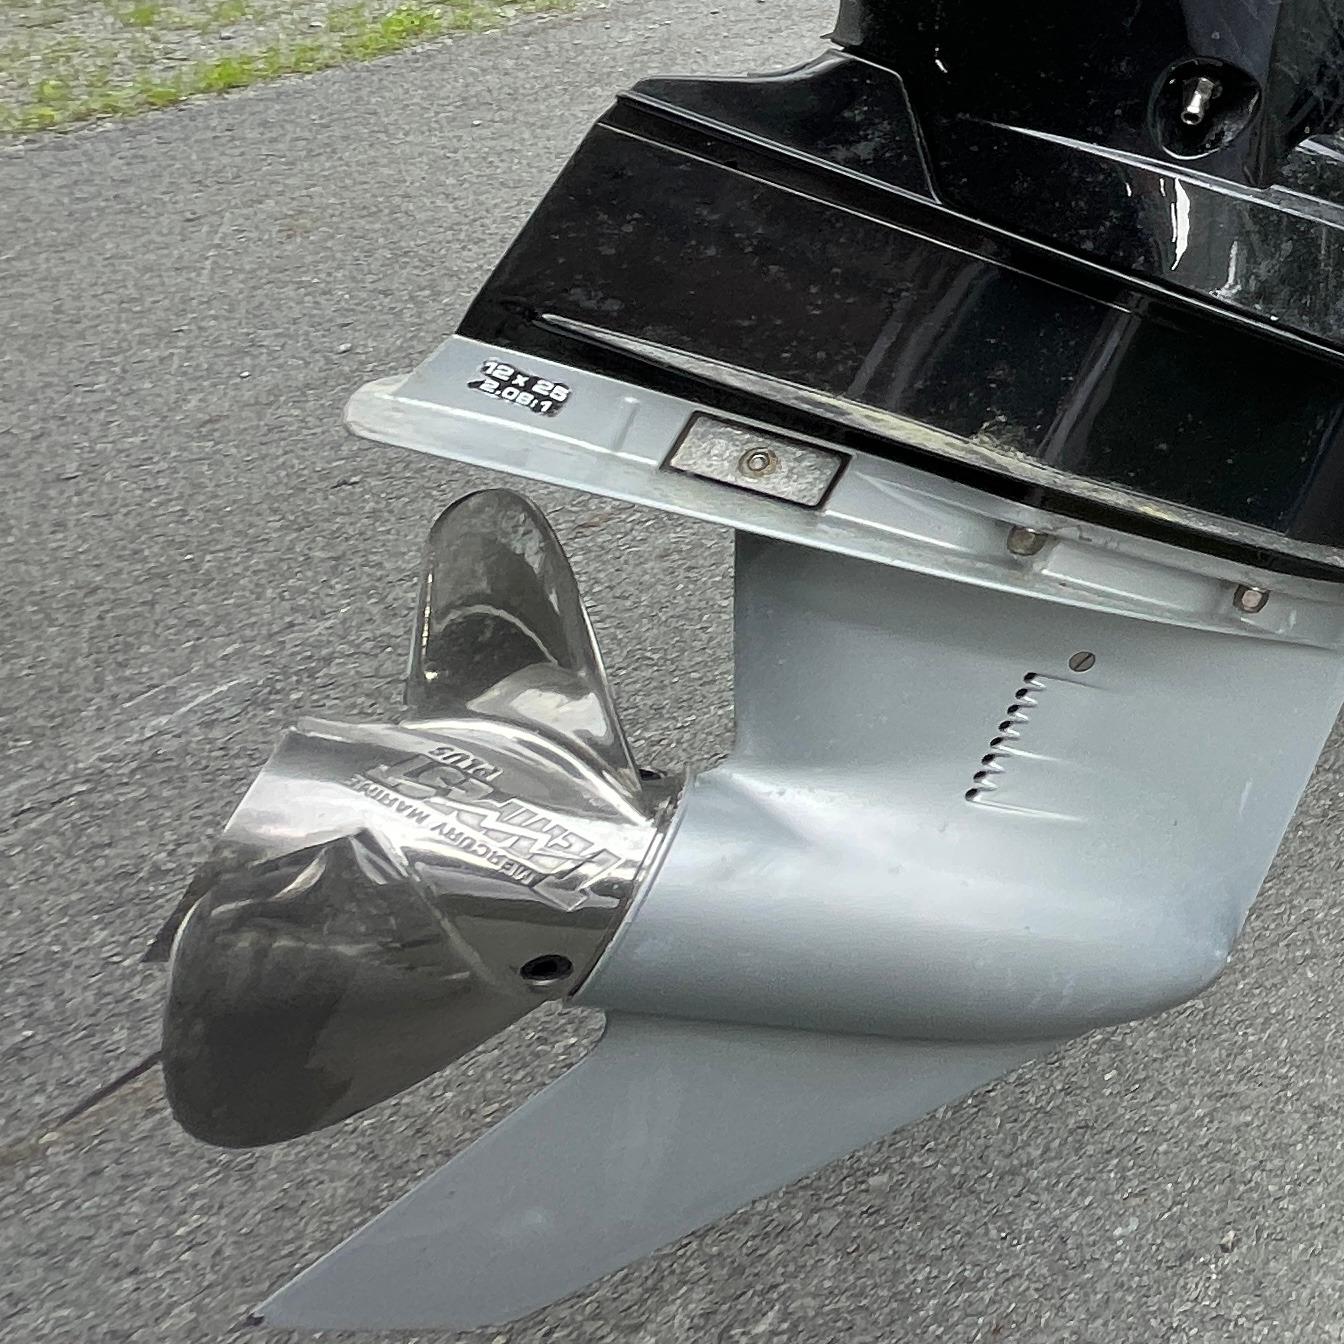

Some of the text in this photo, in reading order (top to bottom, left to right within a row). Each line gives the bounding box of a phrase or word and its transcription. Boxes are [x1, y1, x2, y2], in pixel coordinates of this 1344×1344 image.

[484, 360, 515, 382] 12
[428, 746, 504, 782] PLUS
[350, 773, 547, 885] MERCURY MARINE
